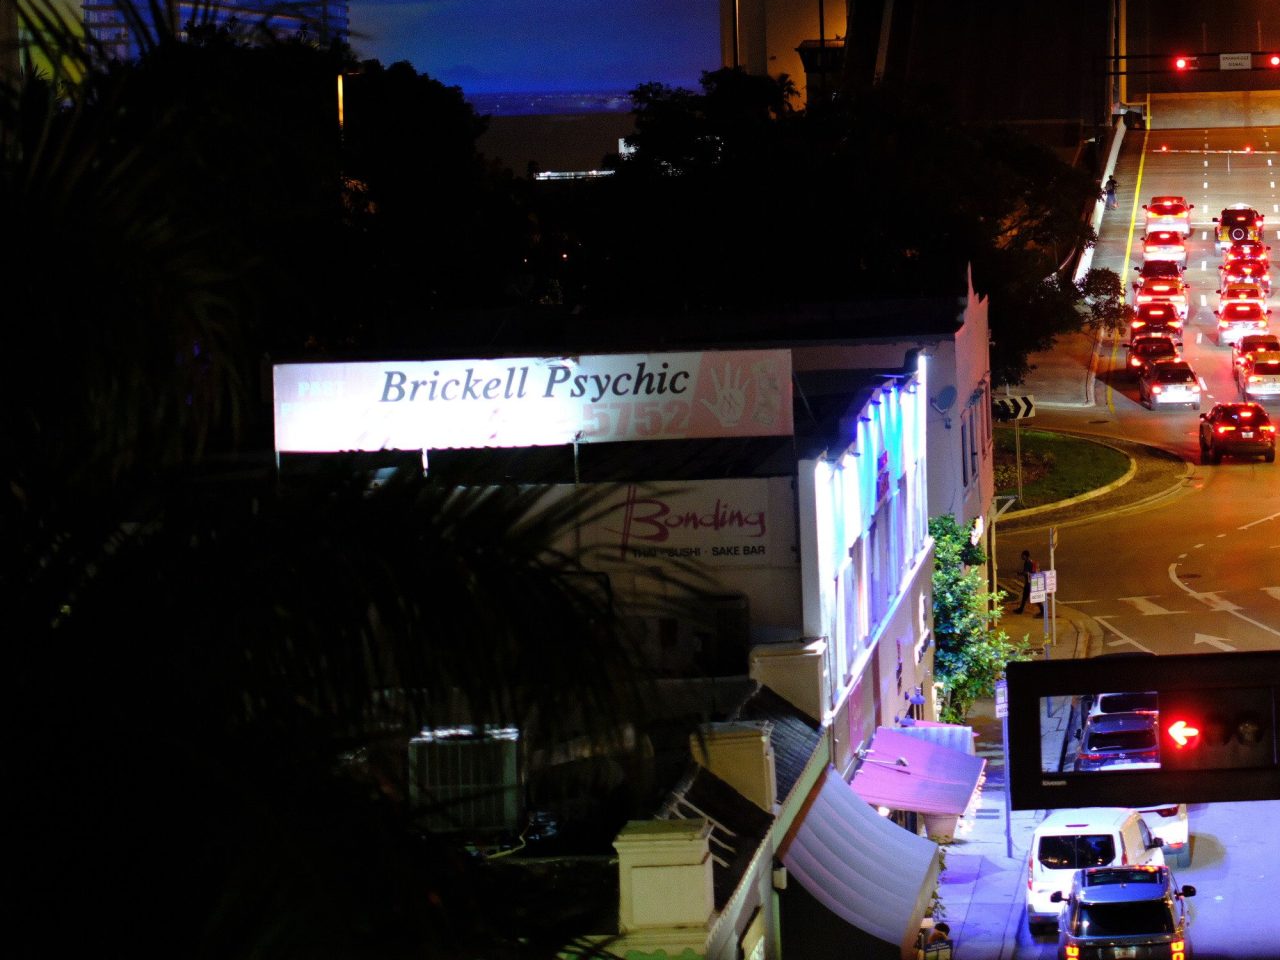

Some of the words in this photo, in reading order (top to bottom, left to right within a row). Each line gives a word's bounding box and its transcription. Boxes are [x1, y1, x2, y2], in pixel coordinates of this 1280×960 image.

[378, 366, 529, 403] Brickell
[542, 361, 690, 403] Psychic
[605, 486, 767, 553] Bonding
[712, 545, 740, 556] SAKE
[743, 544, 766, 556] BAR
